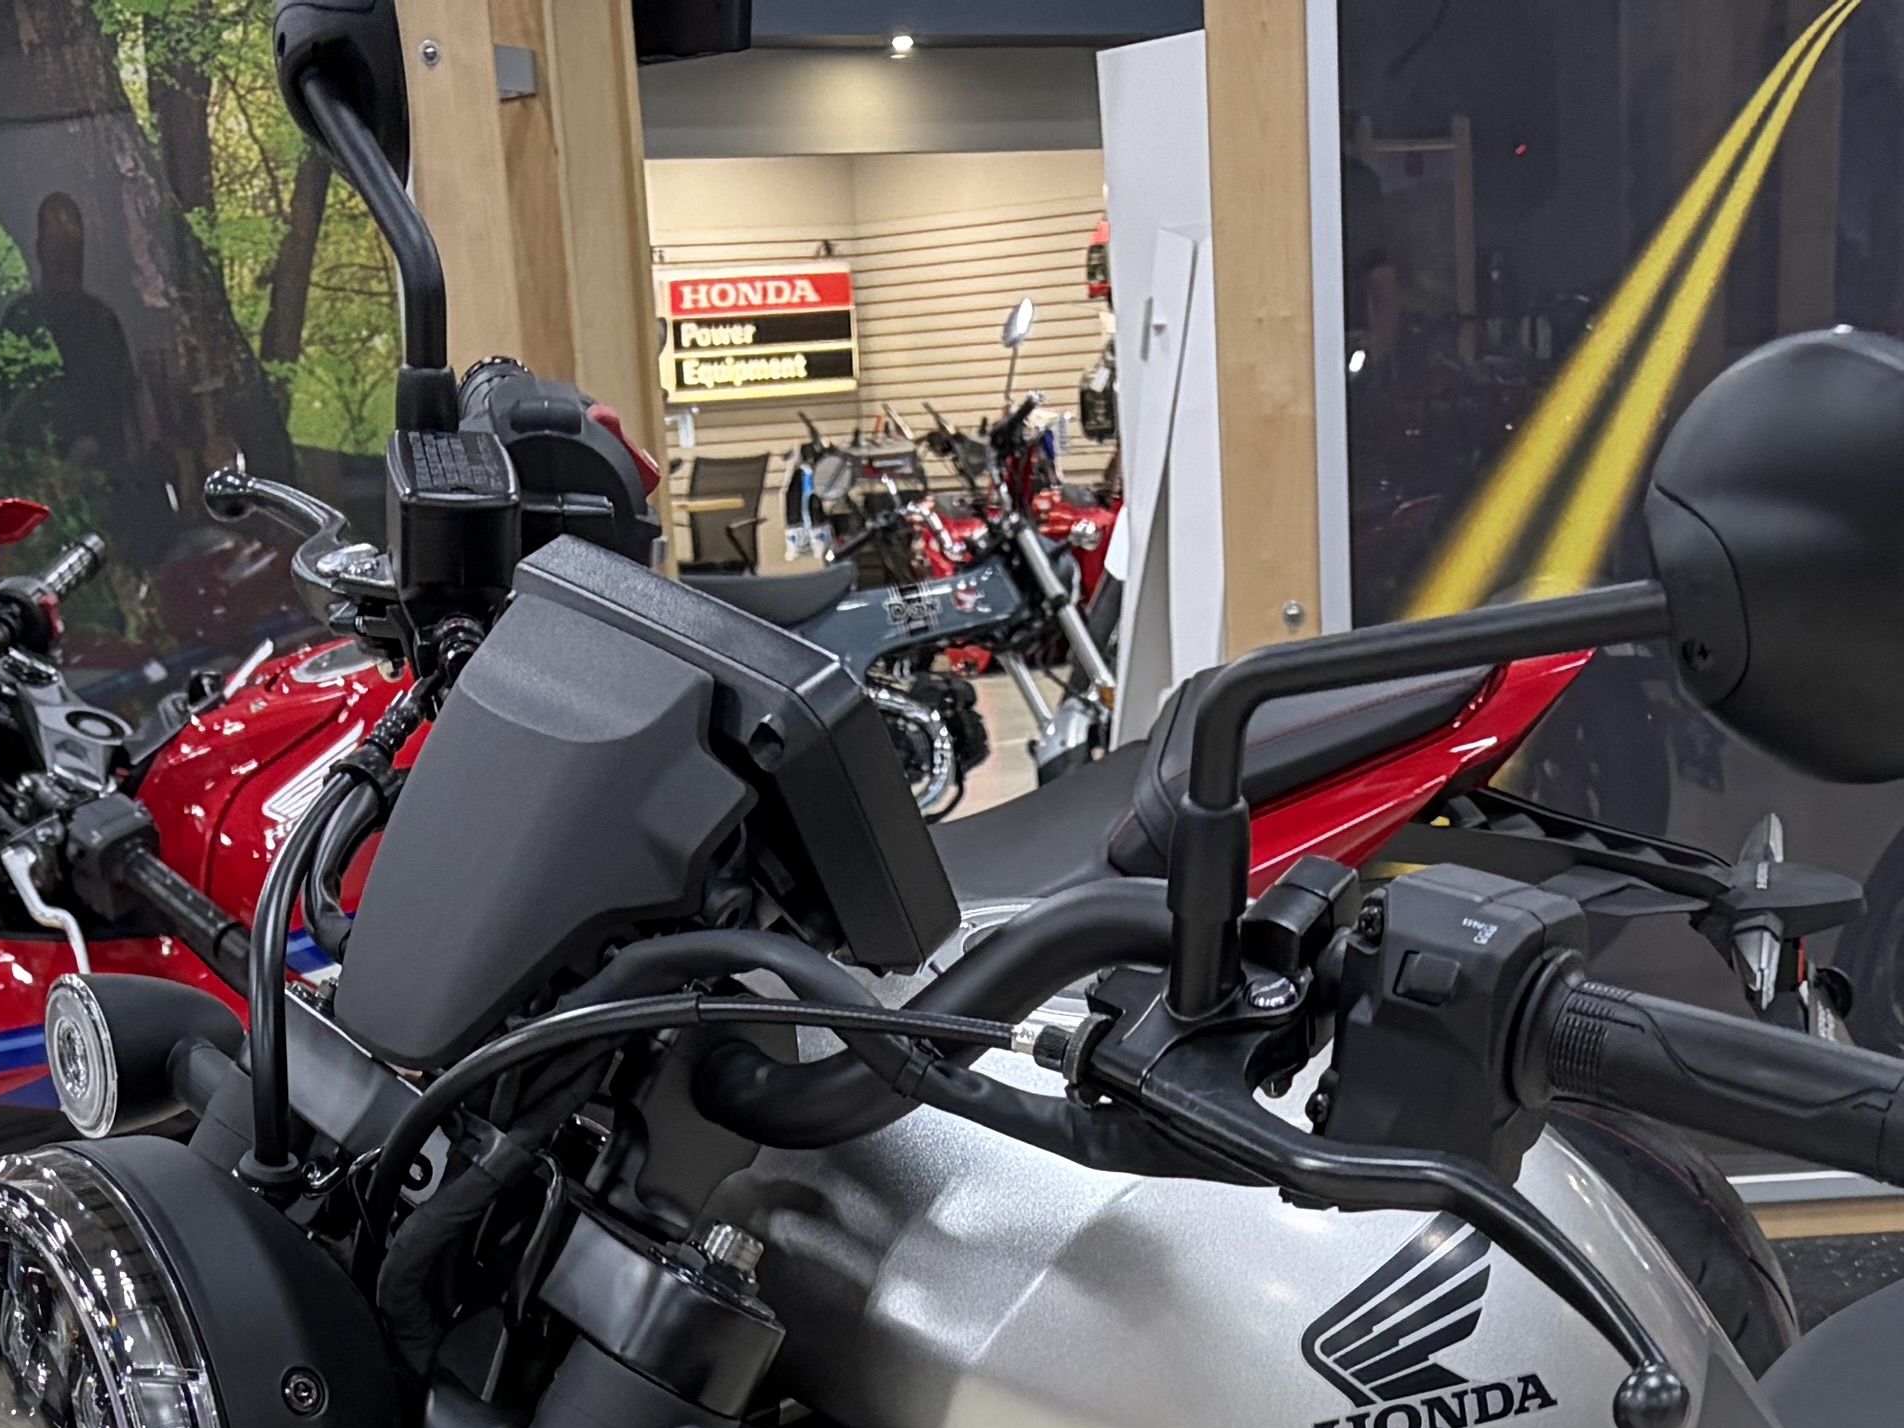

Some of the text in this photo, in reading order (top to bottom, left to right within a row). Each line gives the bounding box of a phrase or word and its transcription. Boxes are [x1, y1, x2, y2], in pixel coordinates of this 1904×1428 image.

[678, 280, 821, 310] HONDA
[679, 320, 757, 348] Power
[682, 352, 808, 388] Equipment
